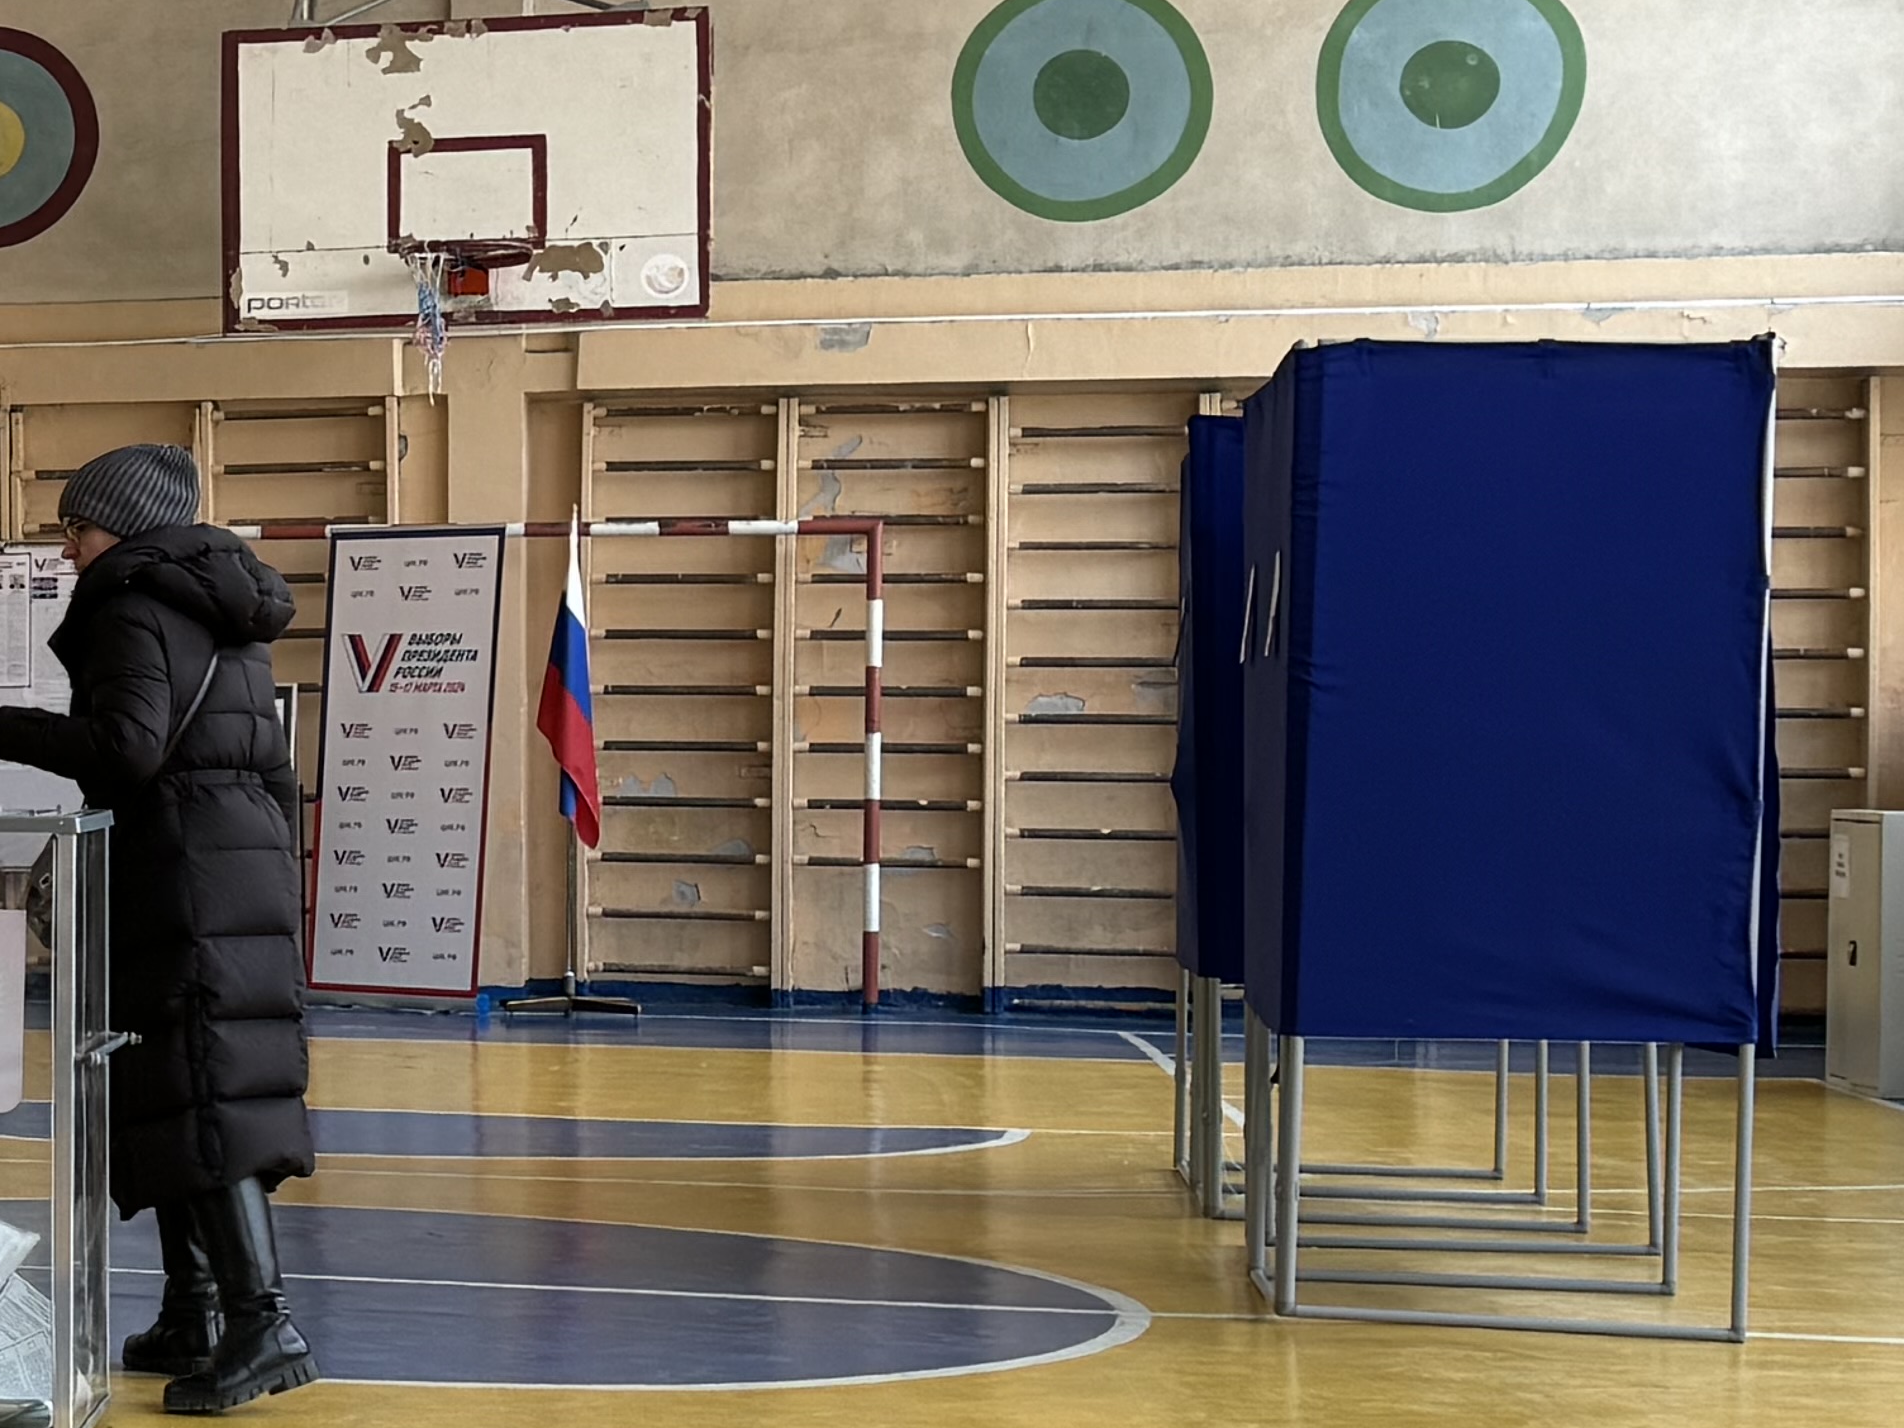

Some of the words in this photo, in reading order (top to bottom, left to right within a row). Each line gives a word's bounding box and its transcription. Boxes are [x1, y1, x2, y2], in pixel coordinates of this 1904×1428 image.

[407, 632, 463, 646] ВЫБОРЫ
[400, 648, 479, 663] ПРЕЗИДЕНТА
[393, 665, 444, 679] РОССИИ
[413, 682, 443, 693] МАРТА
[443, 681, 466, 693] 2024
